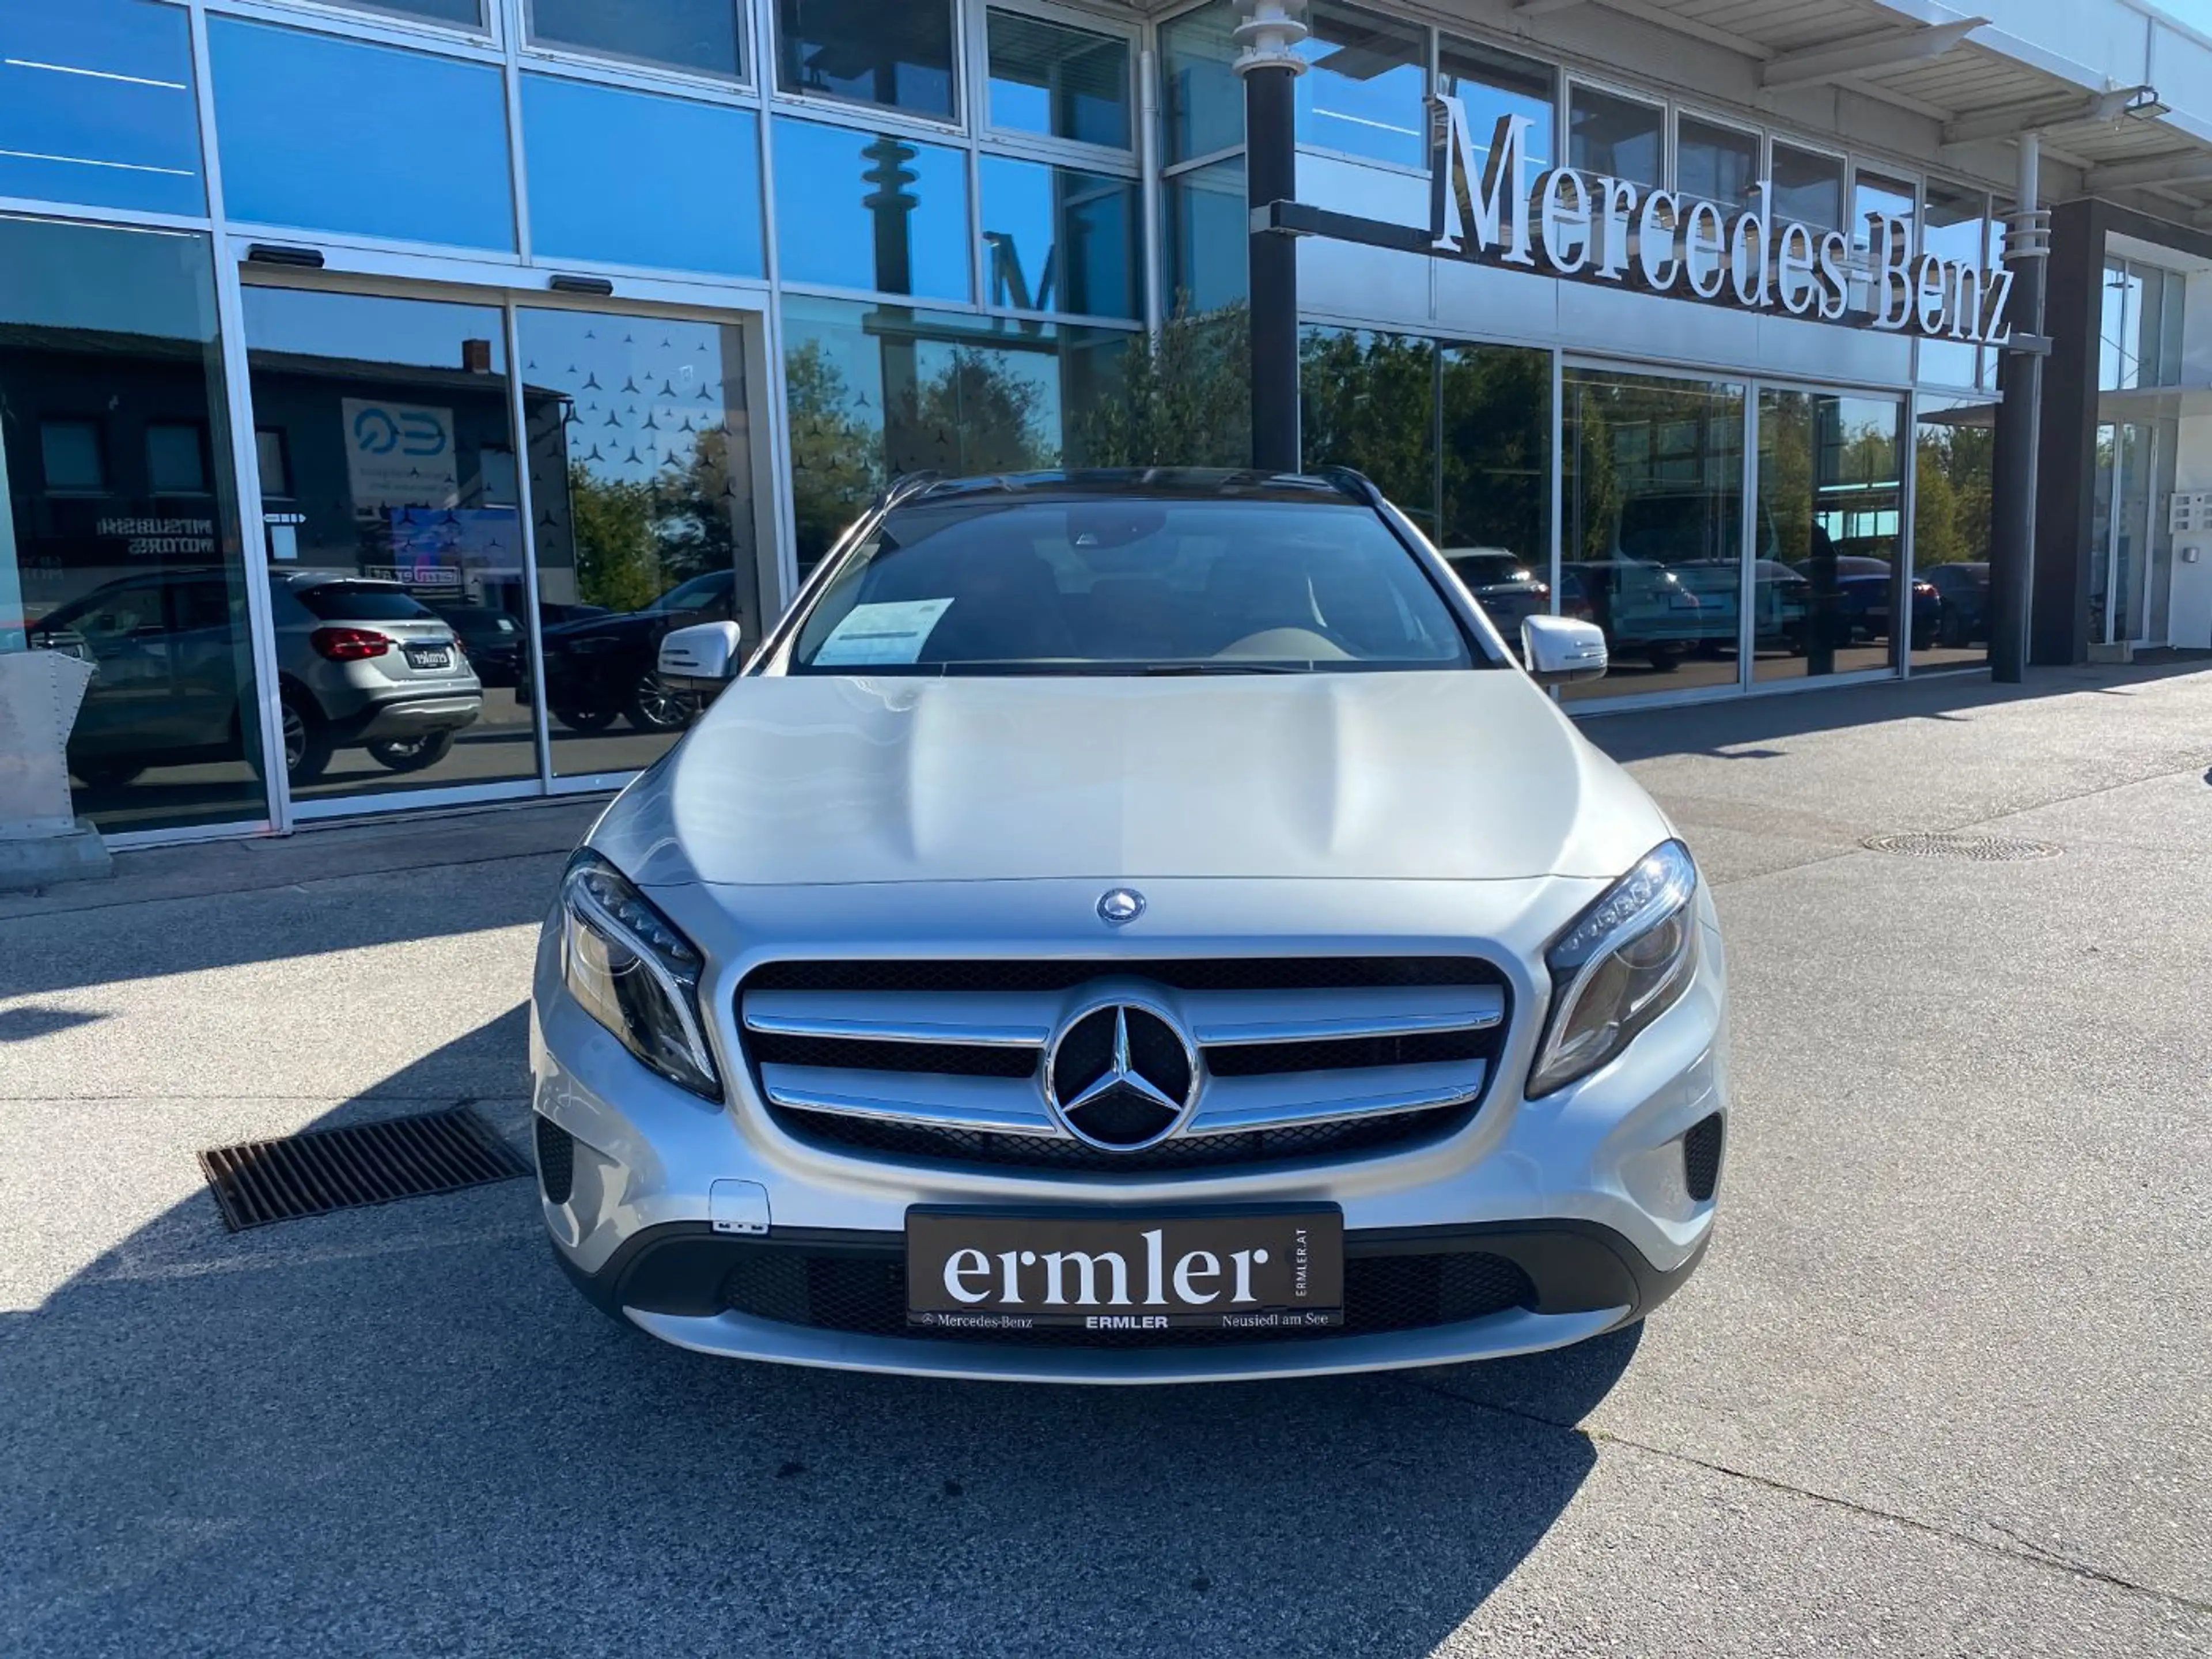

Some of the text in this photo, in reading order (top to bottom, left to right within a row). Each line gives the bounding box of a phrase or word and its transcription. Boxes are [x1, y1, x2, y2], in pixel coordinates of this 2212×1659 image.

[1426, 92, 2014, 346] Mercedes-Benz
[942, 1228, 1270, 1305] ermler
[1295, 1228, 1308, 1297] ERMLER.AT
[937, 1313, 1033, 1329] Mercedes-Benz
[1085, 1316, 1169, 1329] ERMLER
[1222, 1312, 1329, 1327] Neusiedl am See
